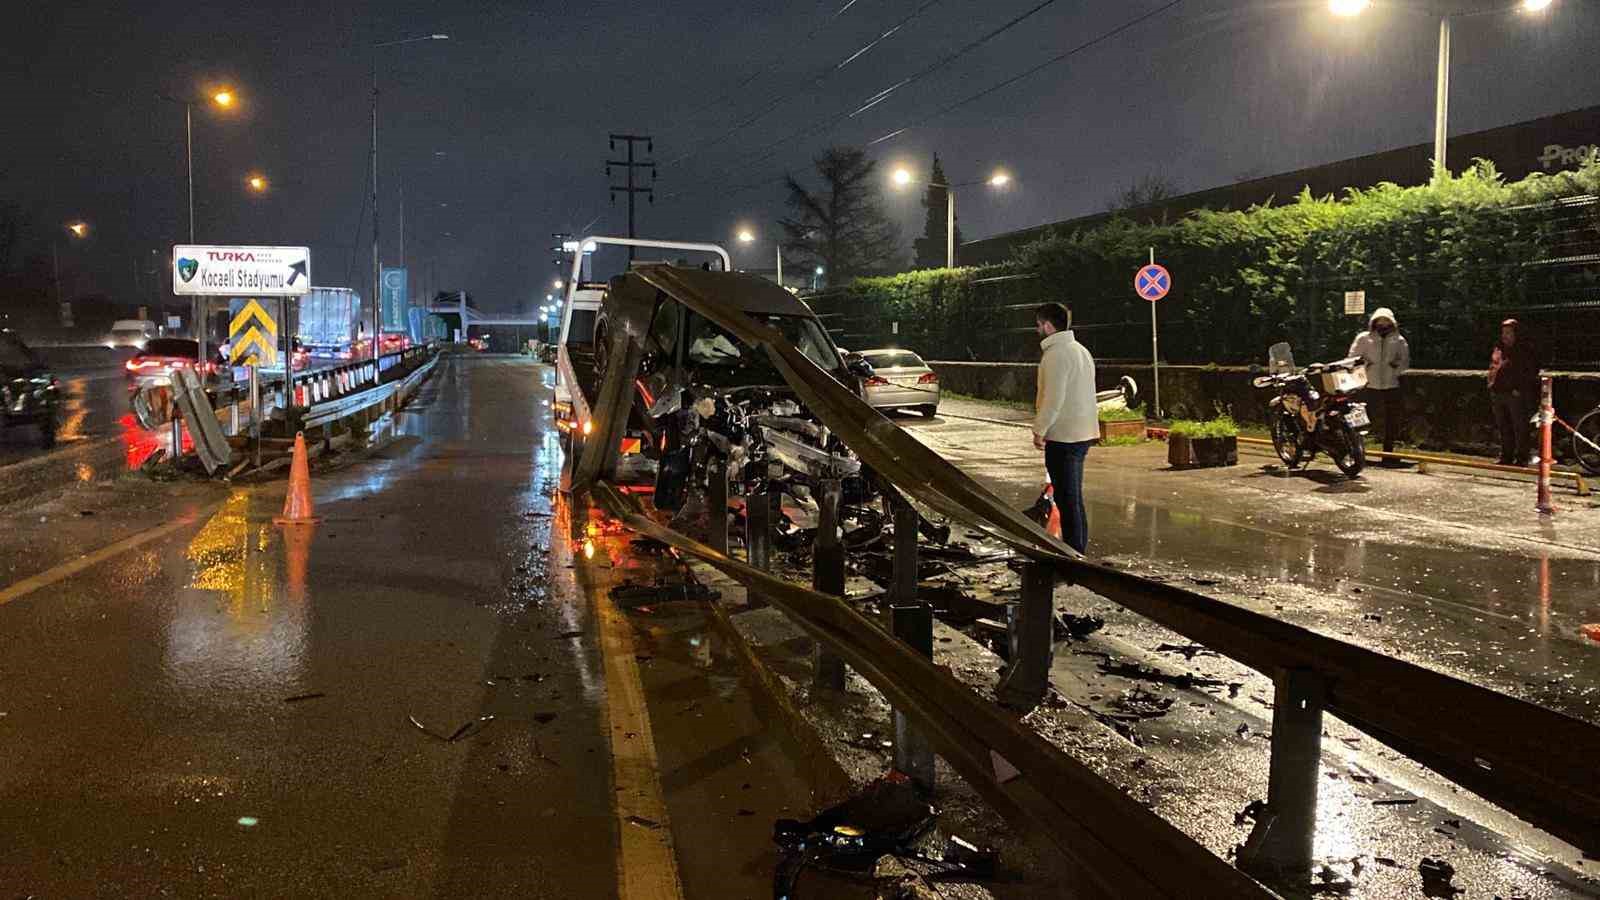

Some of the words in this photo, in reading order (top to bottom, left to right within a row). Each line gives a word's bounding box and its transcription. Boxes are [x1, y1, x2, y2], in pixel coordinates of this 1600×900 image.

[1537, 144, 1594, 168] PRO
[207, 252, 255, 262] TURKA
[201, 269, 235, 287] Kocaeli
[237, 270, 284, 290] Stadyumu
